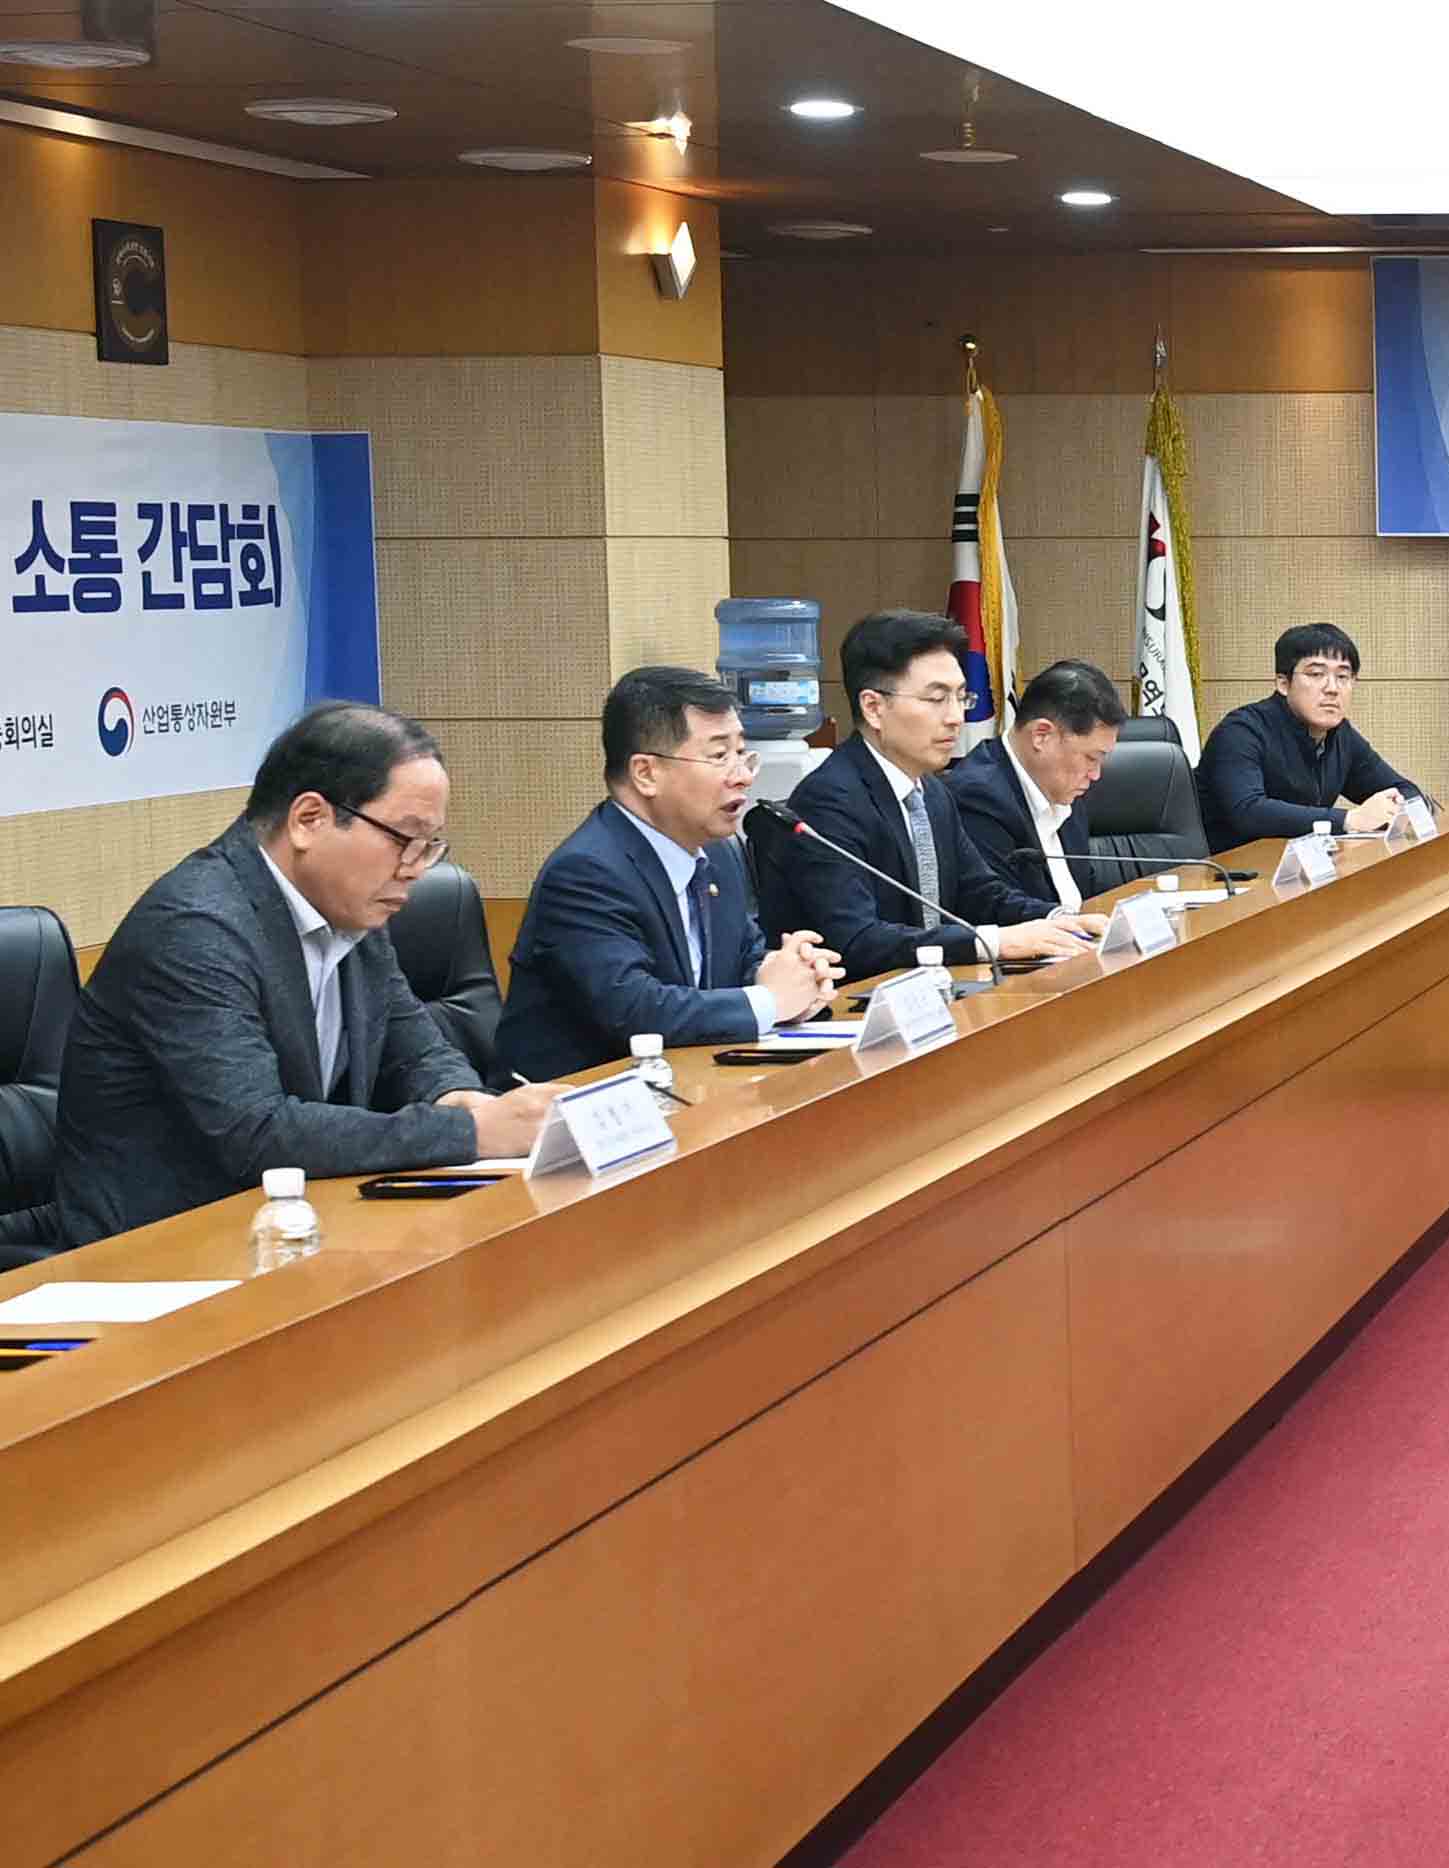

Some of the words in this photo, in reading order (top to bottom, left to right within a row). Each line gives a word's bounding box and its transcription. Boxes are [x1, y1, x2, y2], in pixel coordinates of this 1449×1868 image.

[12, 498, 123, 614] 소통
[136, 500, 283, 611] 간담회
[142, 700, 238, 735] 산업통상자원부
